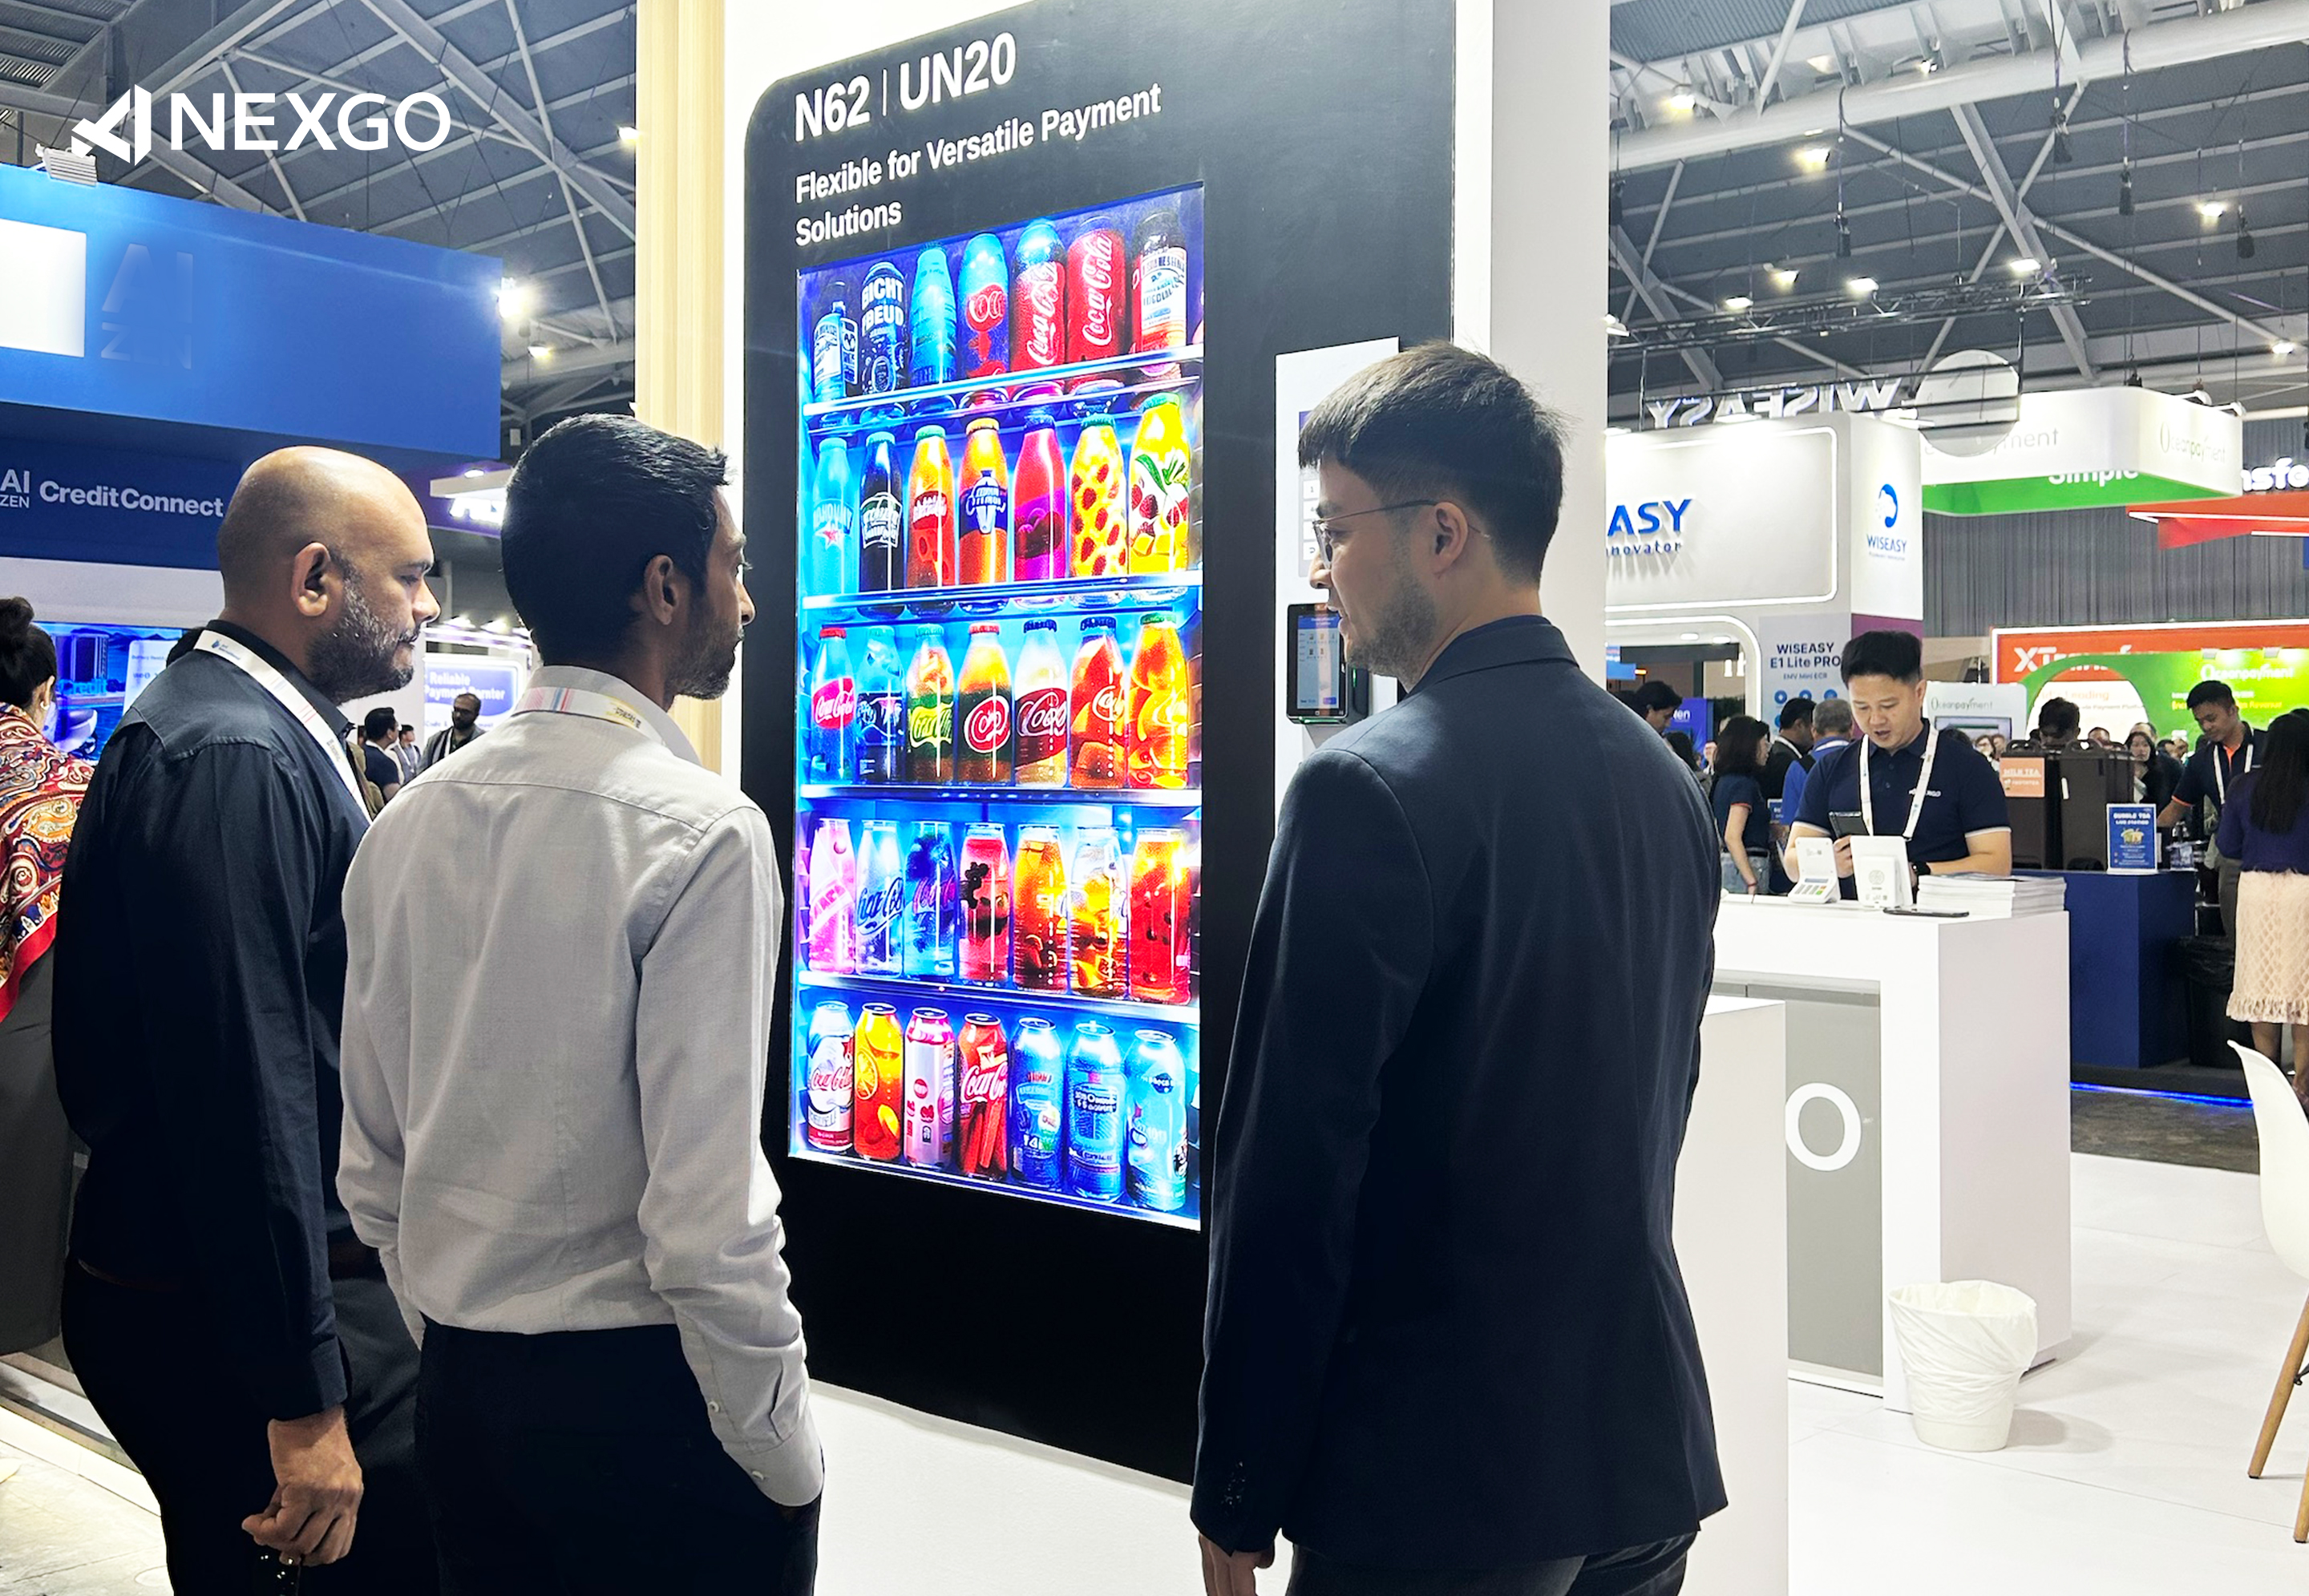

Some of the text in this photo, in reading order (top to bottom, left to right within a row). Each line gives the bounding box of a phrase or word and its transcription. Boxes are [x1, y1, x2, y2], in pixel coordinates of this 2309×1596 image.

[795, 32, 1017, 142] N62 UN20
[795, 83, 1163, 203] Flexible for Versatile Payment
[795, 201, 902, 246] Solutions
[1866, 533, 1907, 553] WISEASY
[1777, 642, 1834, 655] WISEASY
[1770, 656, 1842, 669] E1 Lite PRO
[430, 672, 471, 685] Reliable
